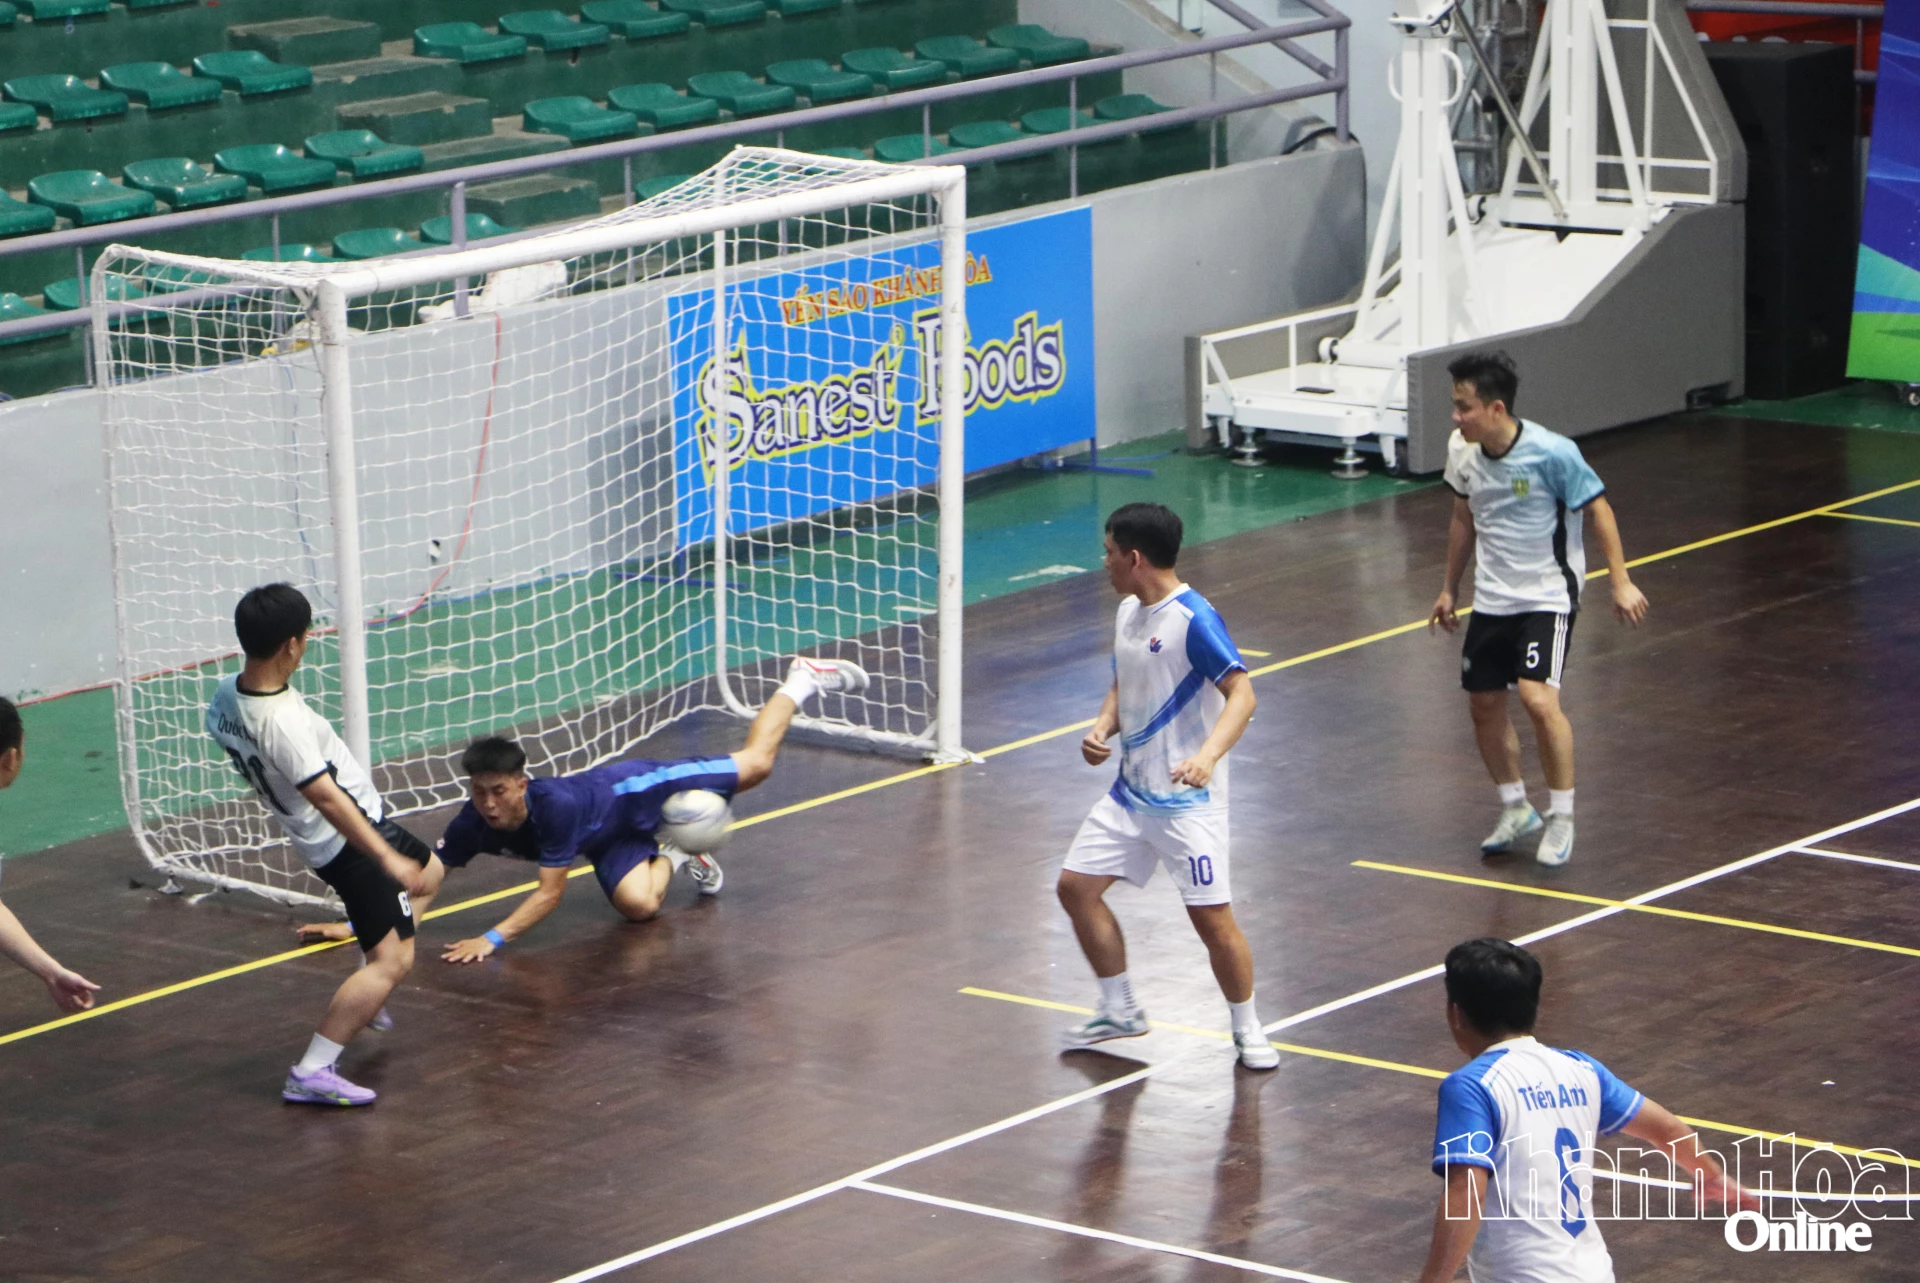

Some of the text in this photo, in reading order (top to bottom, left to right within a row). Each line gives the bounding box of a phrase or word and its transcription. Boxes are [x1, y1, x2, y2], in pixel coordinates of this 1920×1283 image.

[964, 250, 992, 286] ÒA
[697, 343, 898, 473] Sanest
[1525, 642, 1540, 669] 5
[1188, 855, 1214, 887] 10
[1518, 1082, 1556, 1111] Tiến
